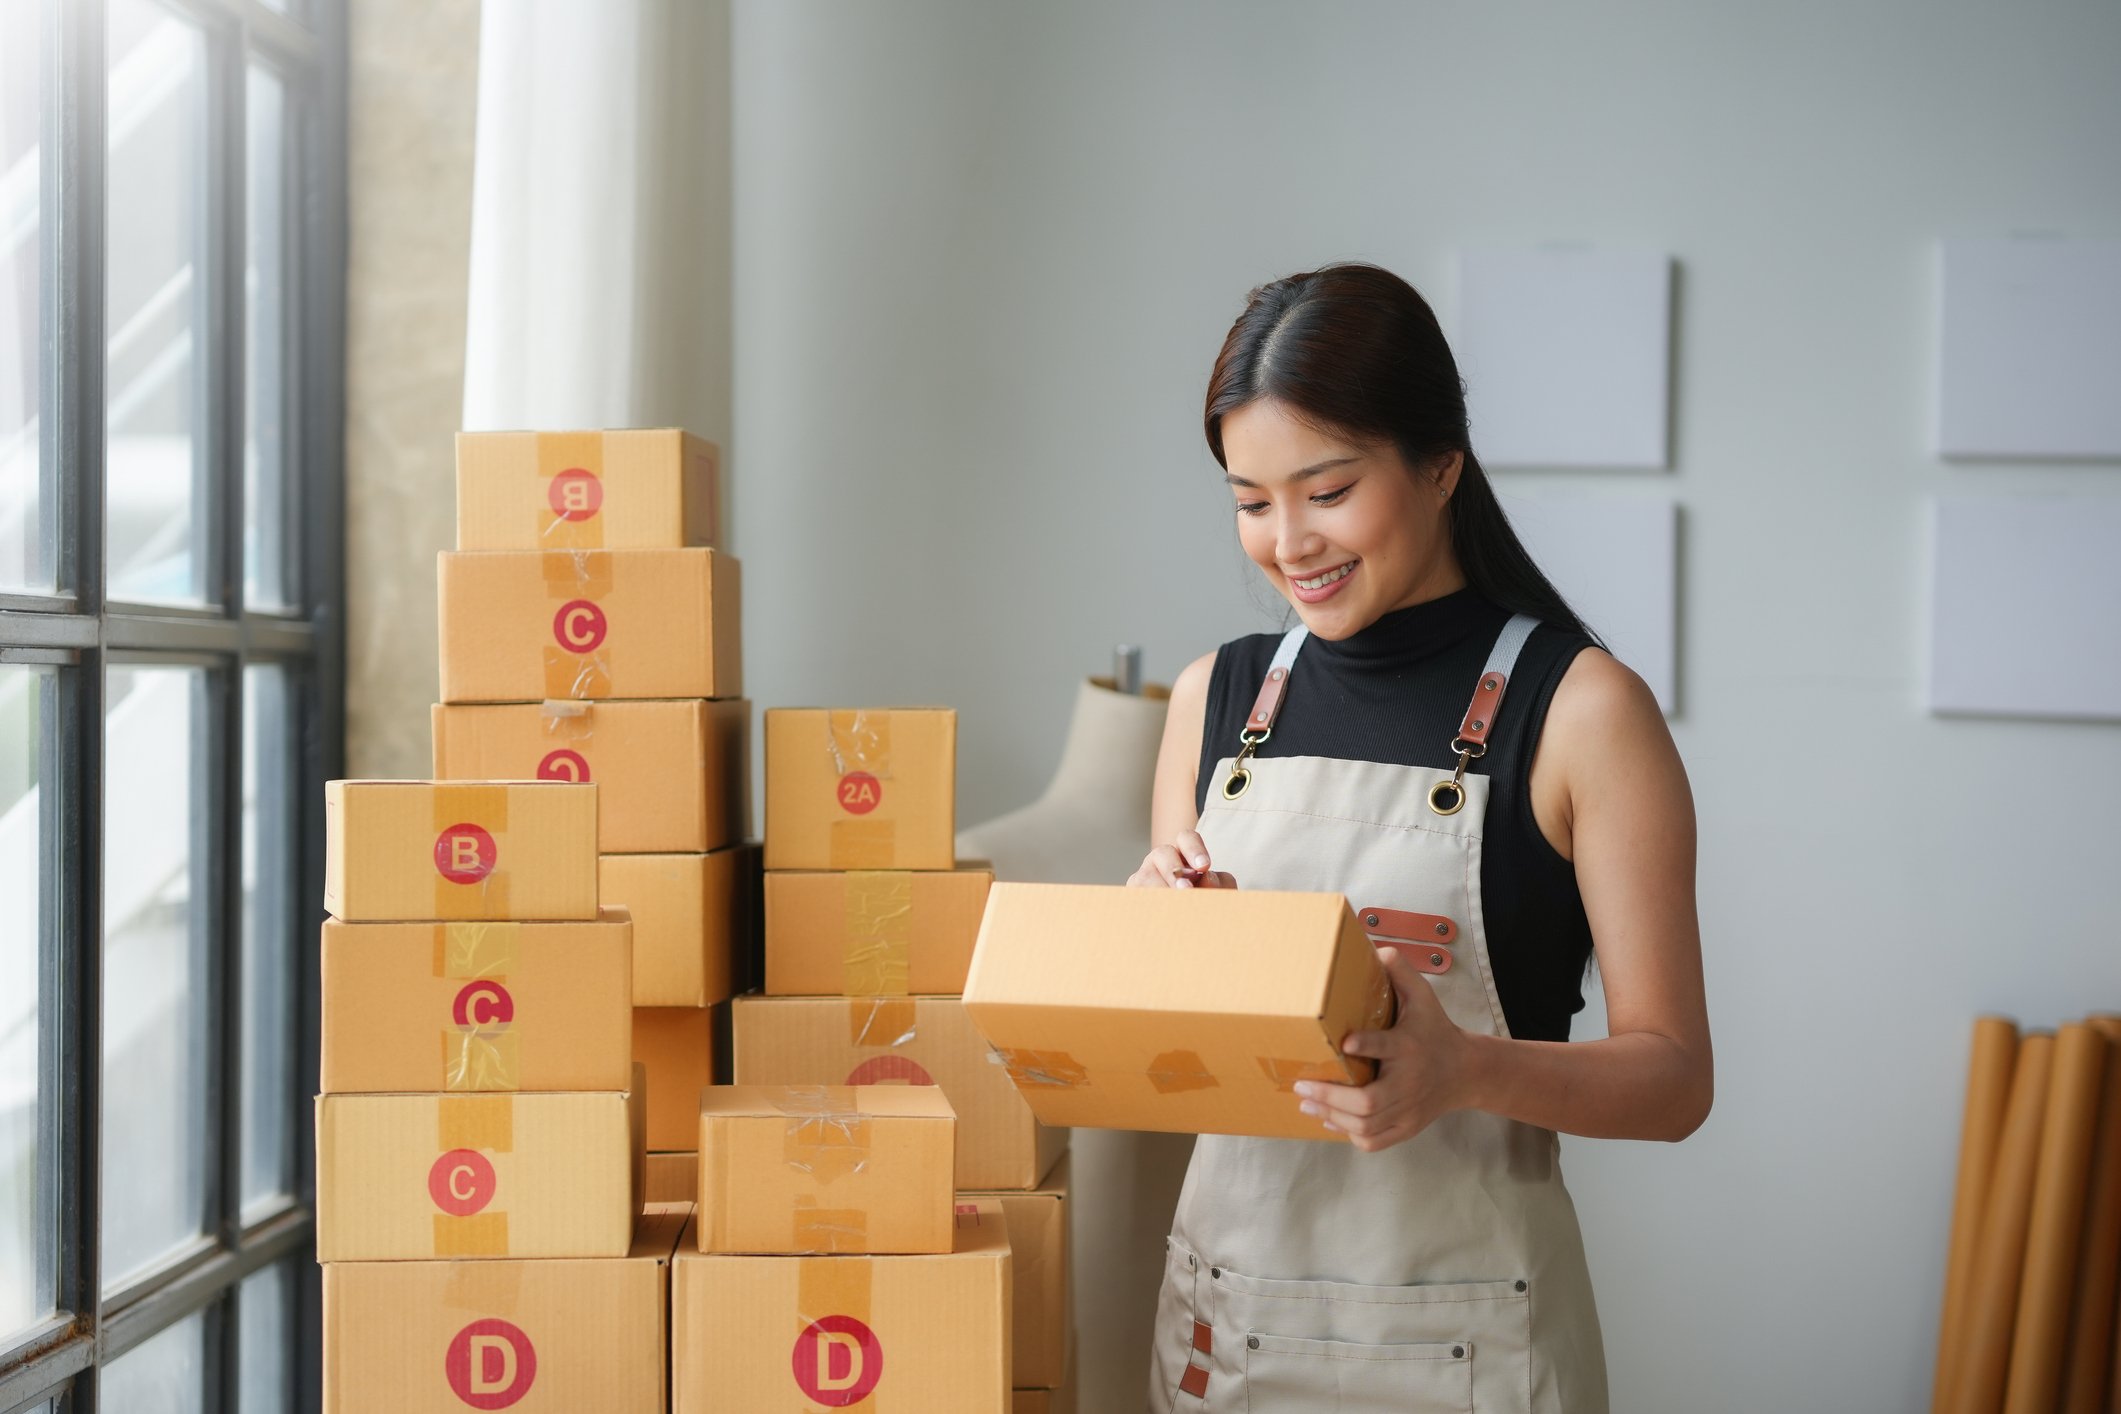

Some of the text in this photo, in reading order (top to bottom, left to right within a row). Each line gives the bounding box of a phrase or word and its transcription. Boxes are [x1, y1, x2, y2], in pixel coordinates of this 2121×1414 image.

[562, 481, 588, 511] B
[564, 607, 595, 646] C
[844, 783, 875, 803] 2A
[451, 836, 480, 870] B
[466, 989, 500, 1033] C
[449, 1165, 476, 1200] C
[470, 1335, 517, 1394] D
[817, 1332, 863, 1390] D
